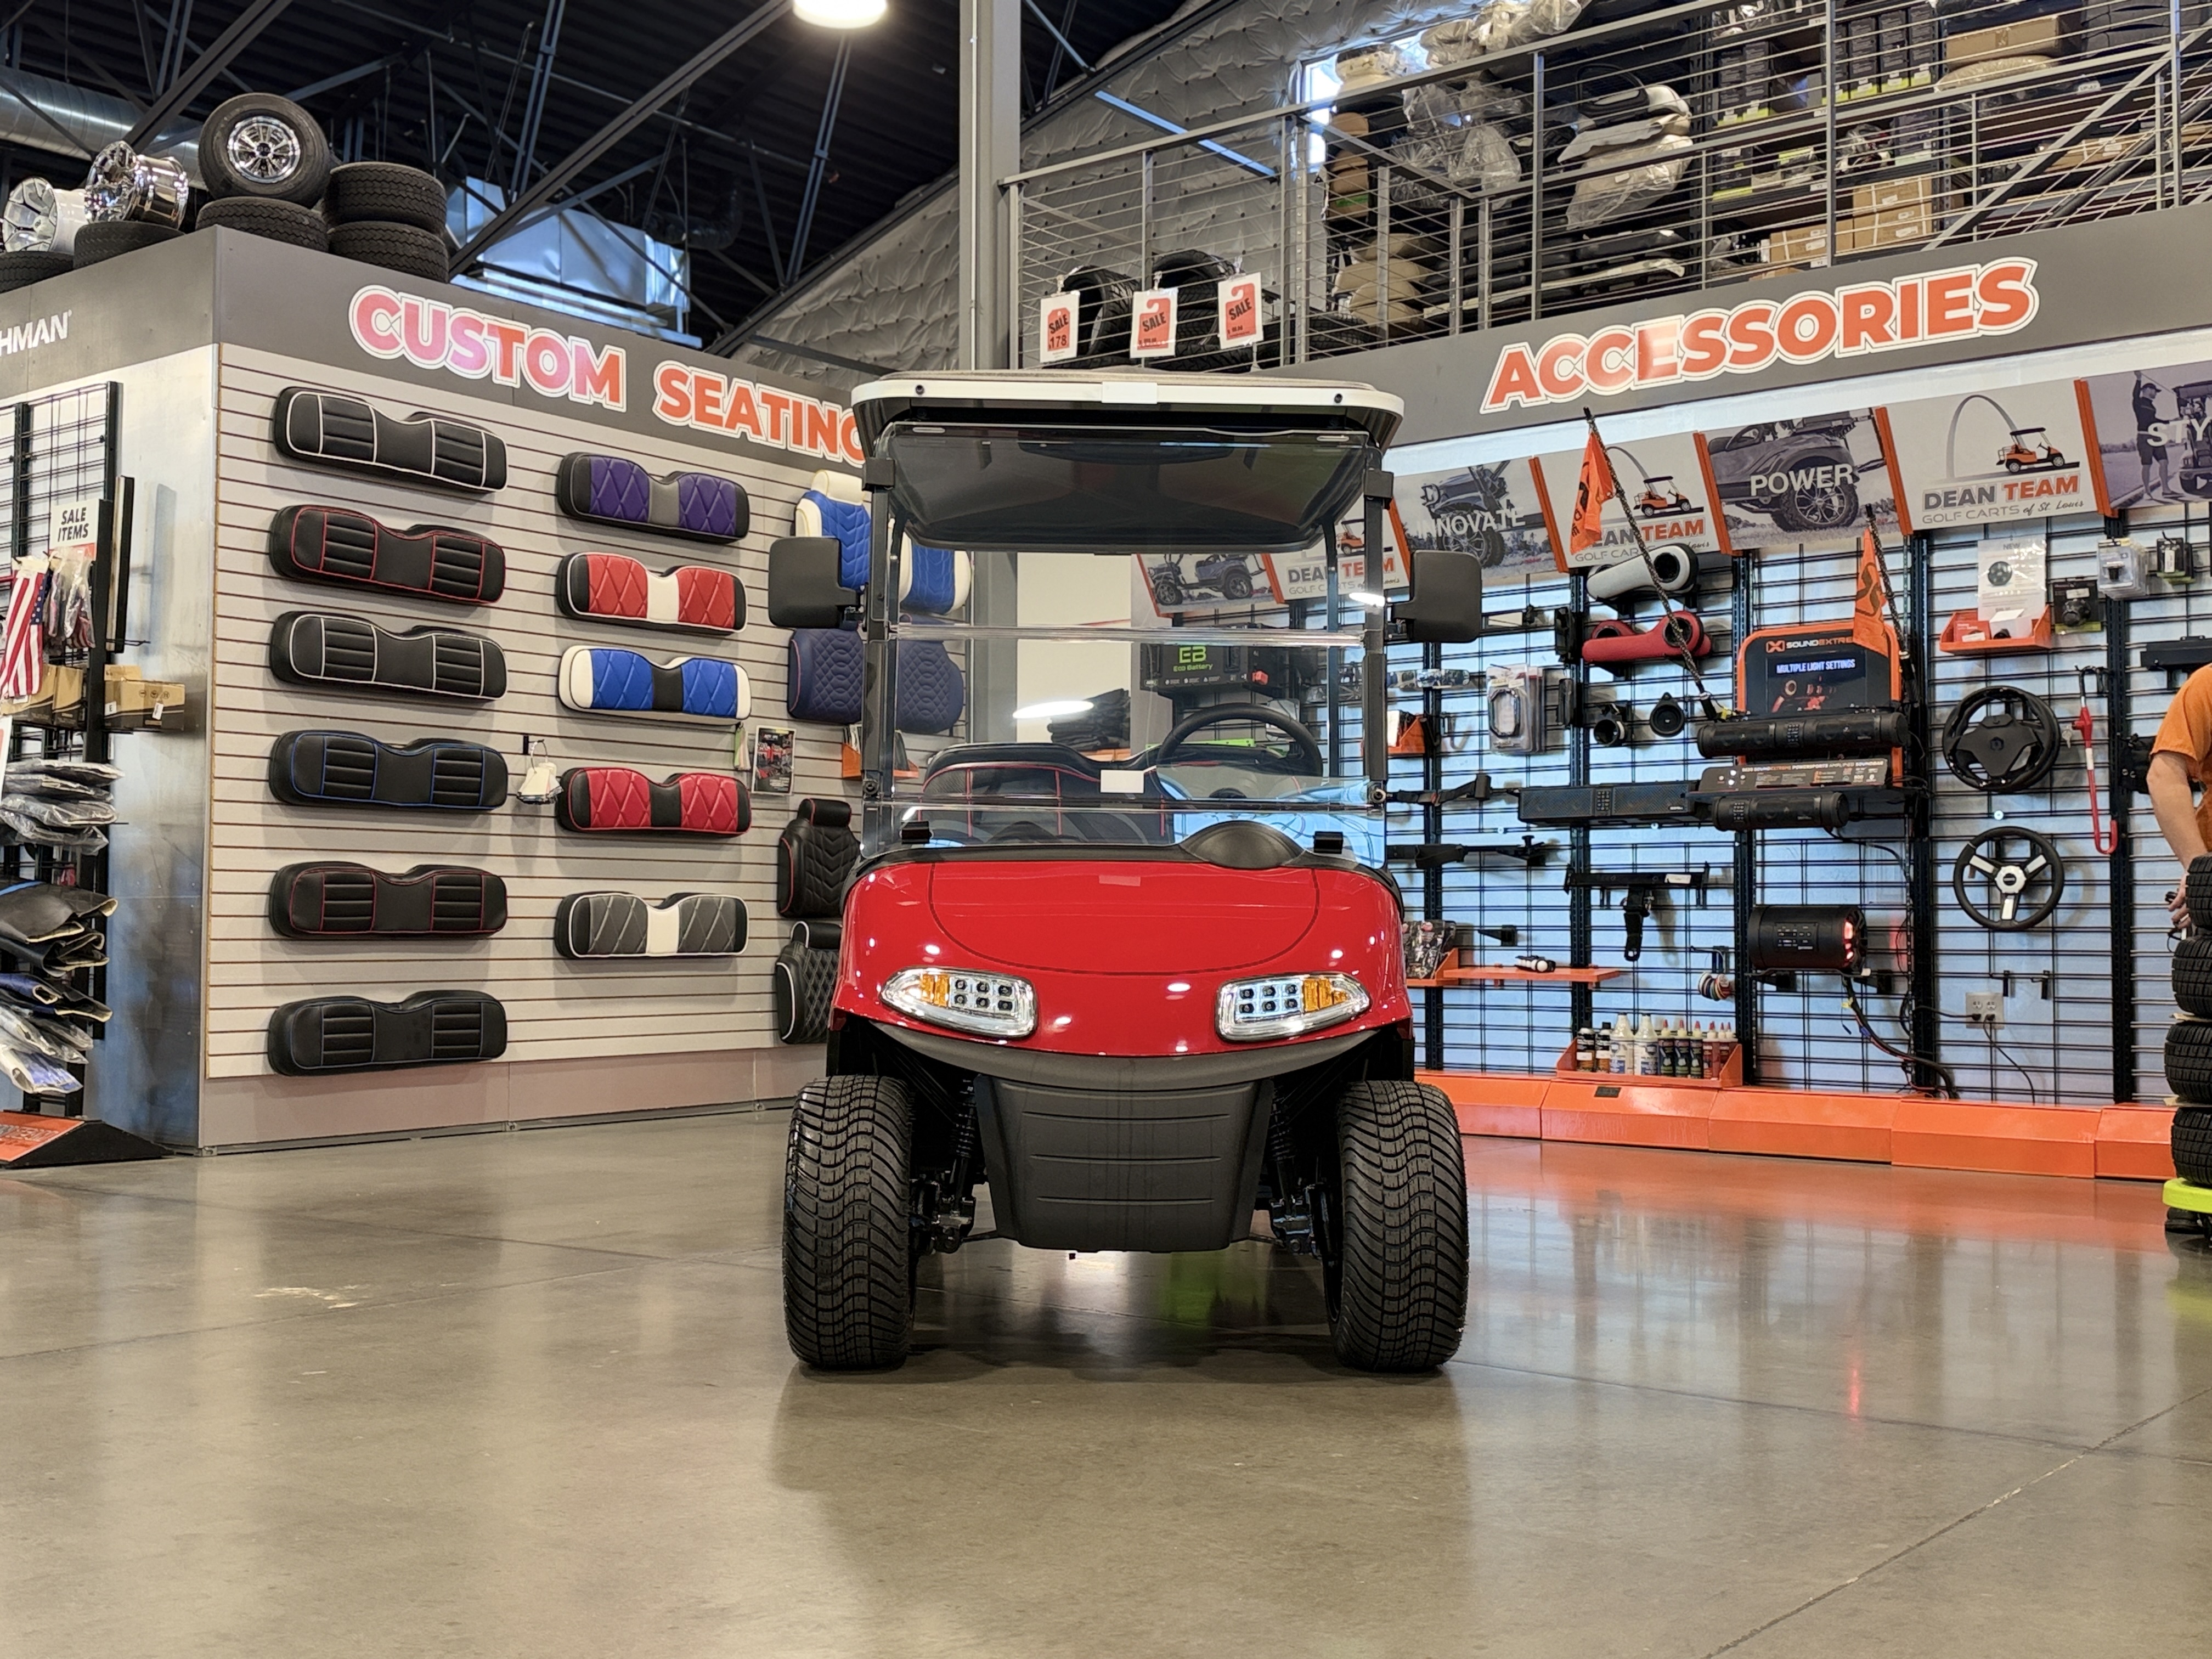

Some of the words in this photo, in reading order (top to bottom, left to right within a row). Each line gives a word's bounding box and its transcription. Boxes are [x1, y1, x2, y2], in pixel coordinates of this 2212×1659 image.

[1228, 298, 1252, 320] SALE
[1048, 314, 1069, 334] SALE
[1142, 312, 1166, 332] SALE
[1480, 257, 2039, 414] ACCESSORIES
[349, 285, 626, 412] CUSTOM
[1750, 464, 1853, 496] POWER
[1925, 486, 1995, 510] DEAN
[2004, 475, 2078, 500] TEAM
[61, 507, 87, 525] SALE
[1922, 511, 1962, 524] GOLF
[1966, 505, 2019, 519] CARTS
[2023, 503, 2035, 516] of
[2056, 499, 2084, 510] Louis
[58, 523, 89, 542] ITEMS
[1417, 507, 1526, 539] INNOVATE
[1592, 528, 1635, 548] AN
[1641, 519, 1704, 541] TEAM
[1575, 550, 1608, 562] GOLF
[1288, 566, 1328, 583] DEA
[1341, 557, 1394, 577] TEM
[1289, 585, 1318, 595] GOLF
[1318, 580, 1356, 592] CTS
[1786, 636, 1853, 649] SOUNDEXTRE
[1180, 646, 1206, 663] EB
[1776, 663, 1807, 674] MULTIPLE
[1807, 661, 1825, 672] LIGHT
[1825, 658, 1855, 670] SETTINGS
